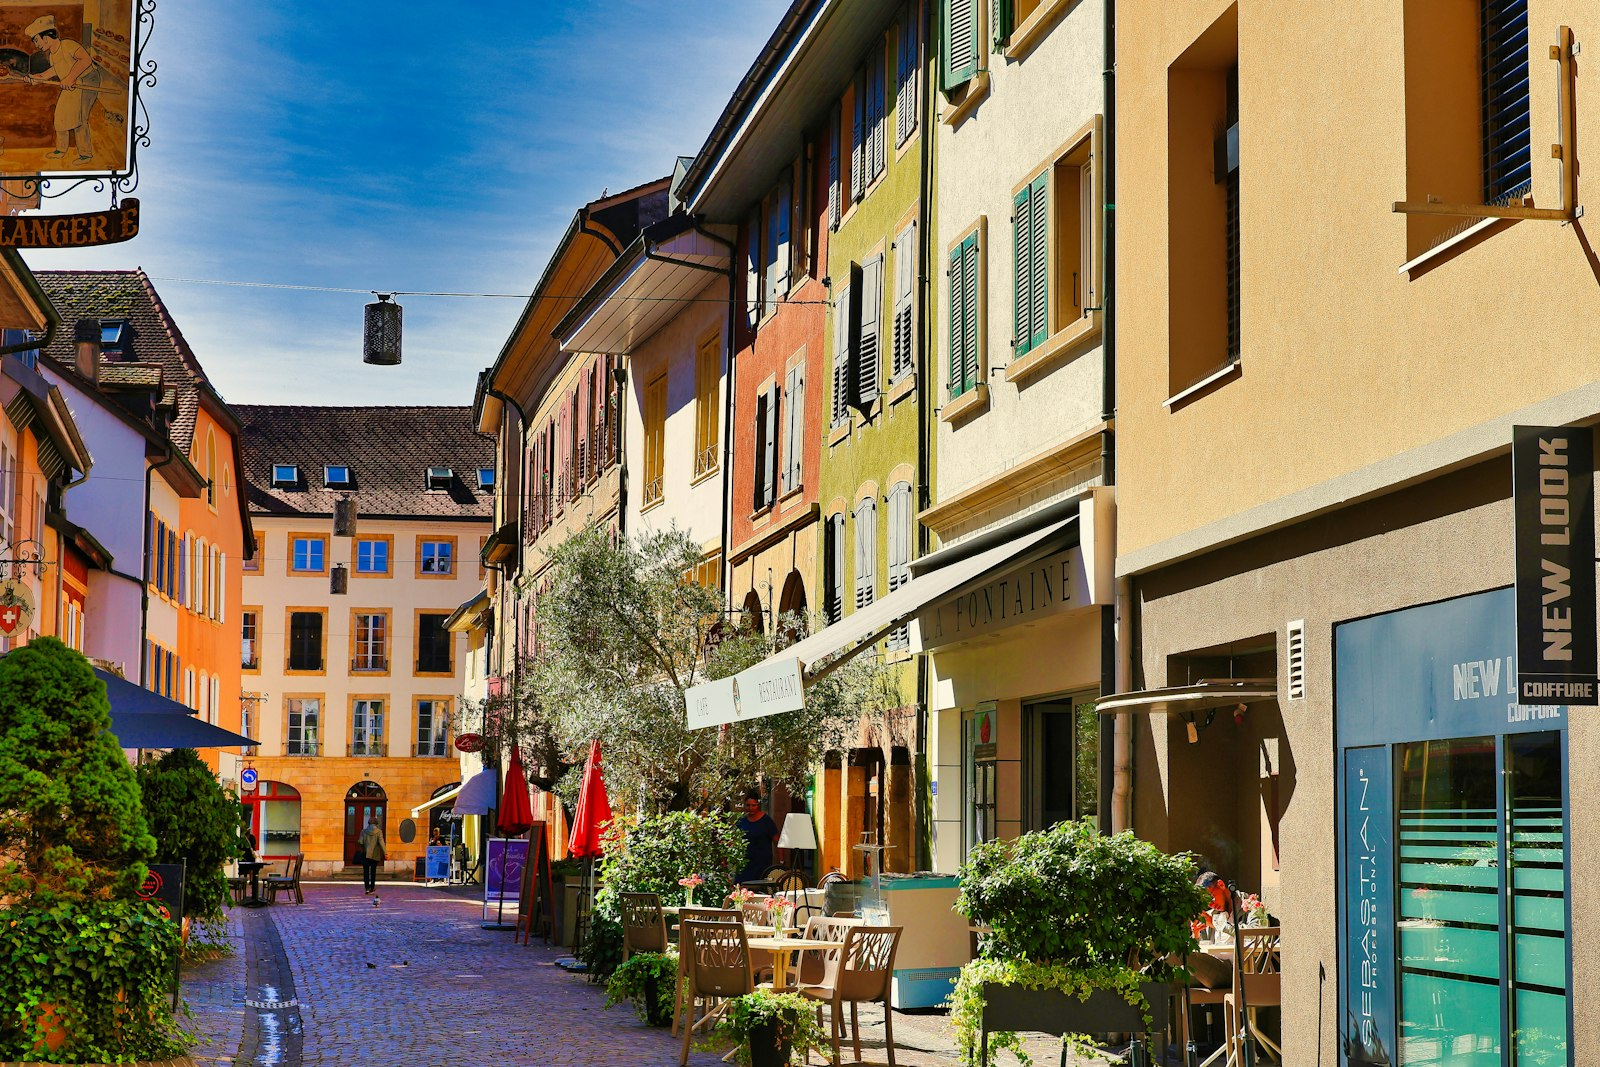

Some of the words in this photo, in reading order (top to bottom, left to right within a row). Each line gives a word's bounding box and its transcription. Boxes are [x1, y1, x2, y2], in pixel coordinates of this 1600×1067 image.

[0, 209, 138, 246] LANGERE
[1539, 437, 1570, 545] LOOK
[923, 607, 943, 642] LA
[956, 560, 1071, 632] FONTAINE
[1541, 559, 1572, 661] NEW
[758, 674, 797, 703] RESTAURANT
[1453, 658, 1501, 700] NEW
[1523, 682, 1592, 698] COIFFURE
